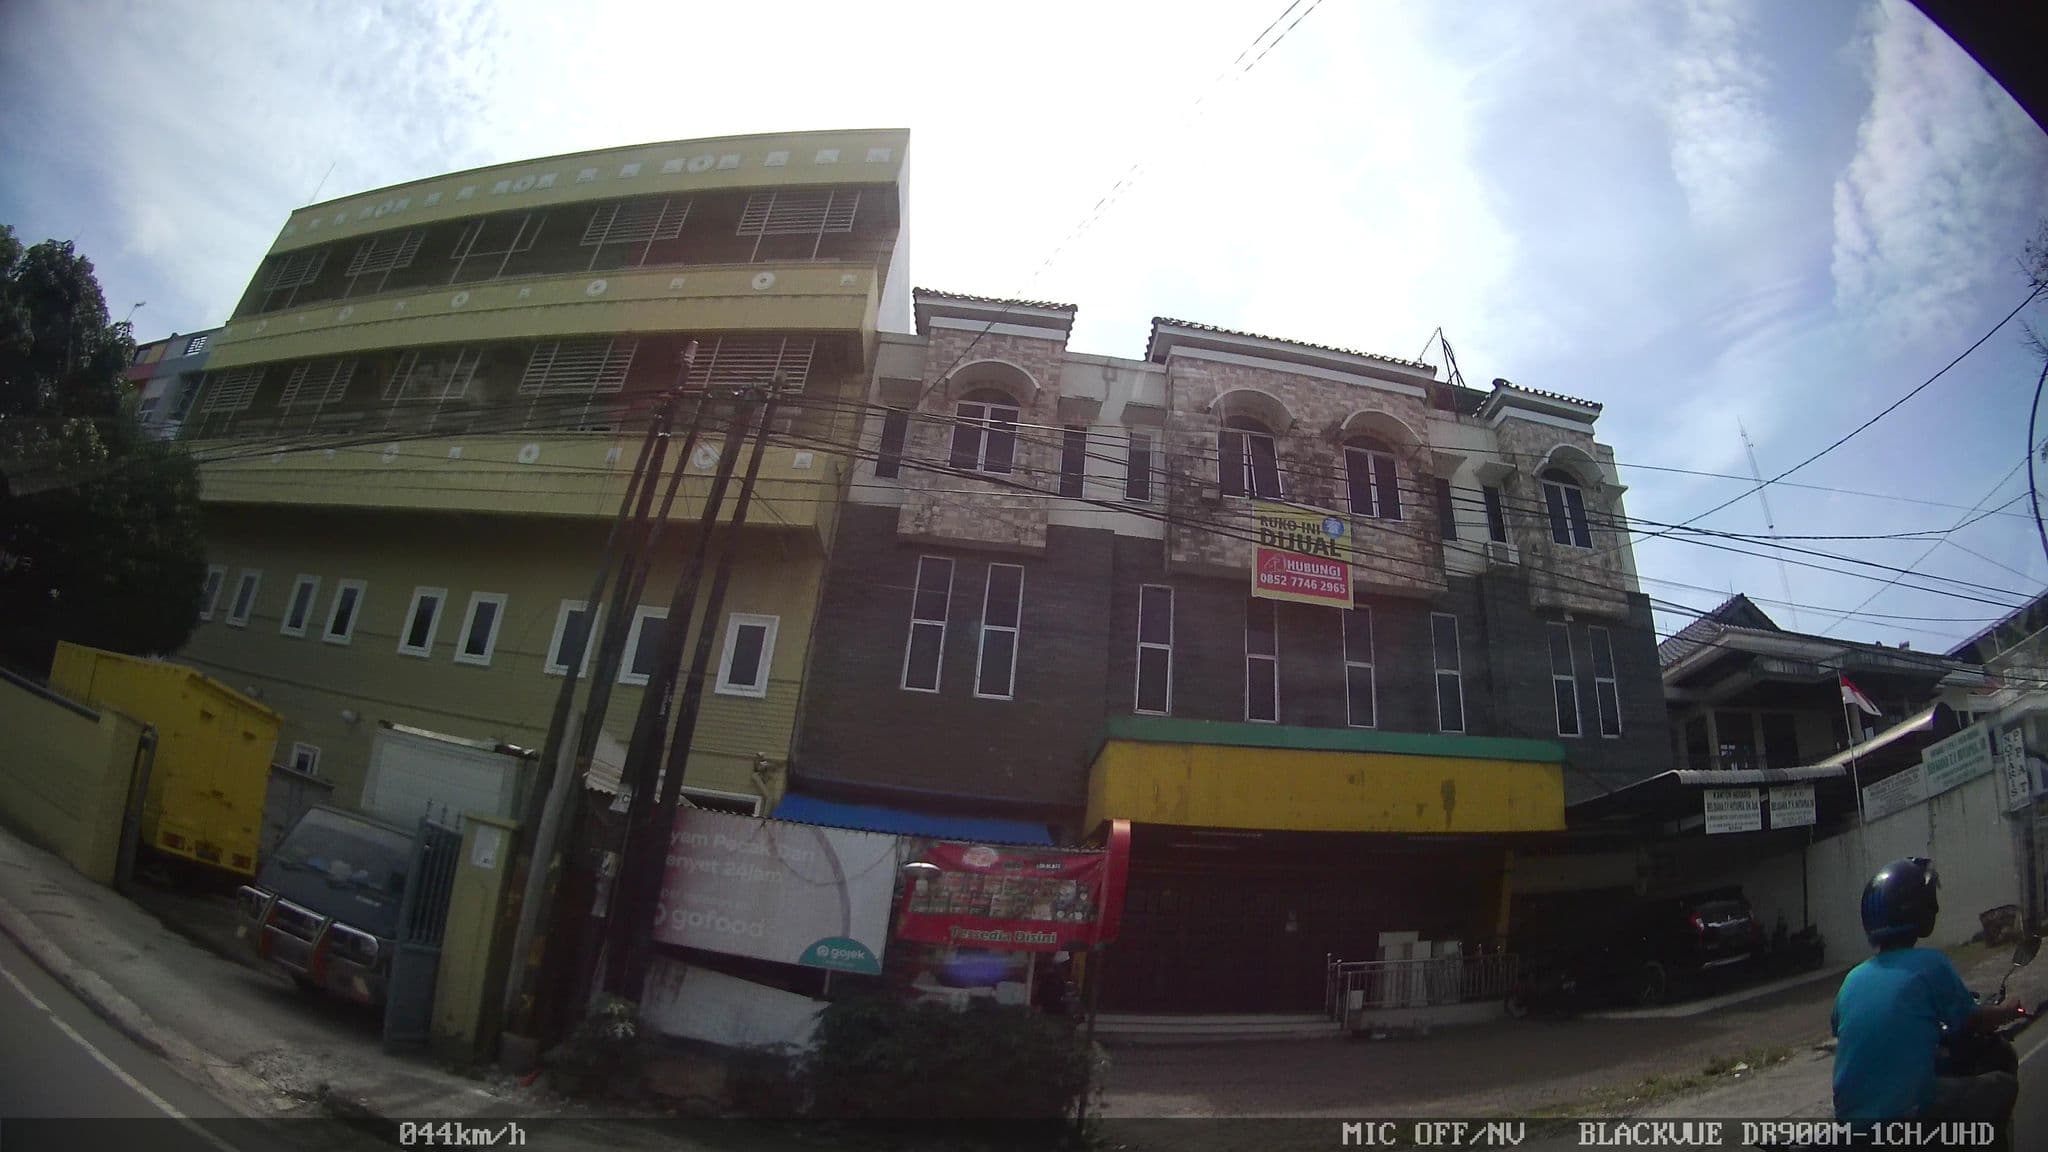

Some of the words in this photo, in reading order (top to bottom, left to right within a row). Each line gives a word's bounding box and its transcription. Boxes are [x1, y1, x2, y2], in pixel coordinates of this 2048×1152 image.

[1260, 515, 1298, 531] RUKO
[1302, 521, 1322, 536] INI
[1260, 527, 1342, 558] DIJUAL
[1287, 559, 1341, 577] HUBUNGI
[1260, 573, 1287, 586] 0852
[1291, 577, 1318, 590] 7746
[1320, 581, 1346, 594] 2965
[1014, 930, 1058, 944] Disini
[830, 947, 866, 961] gojek
